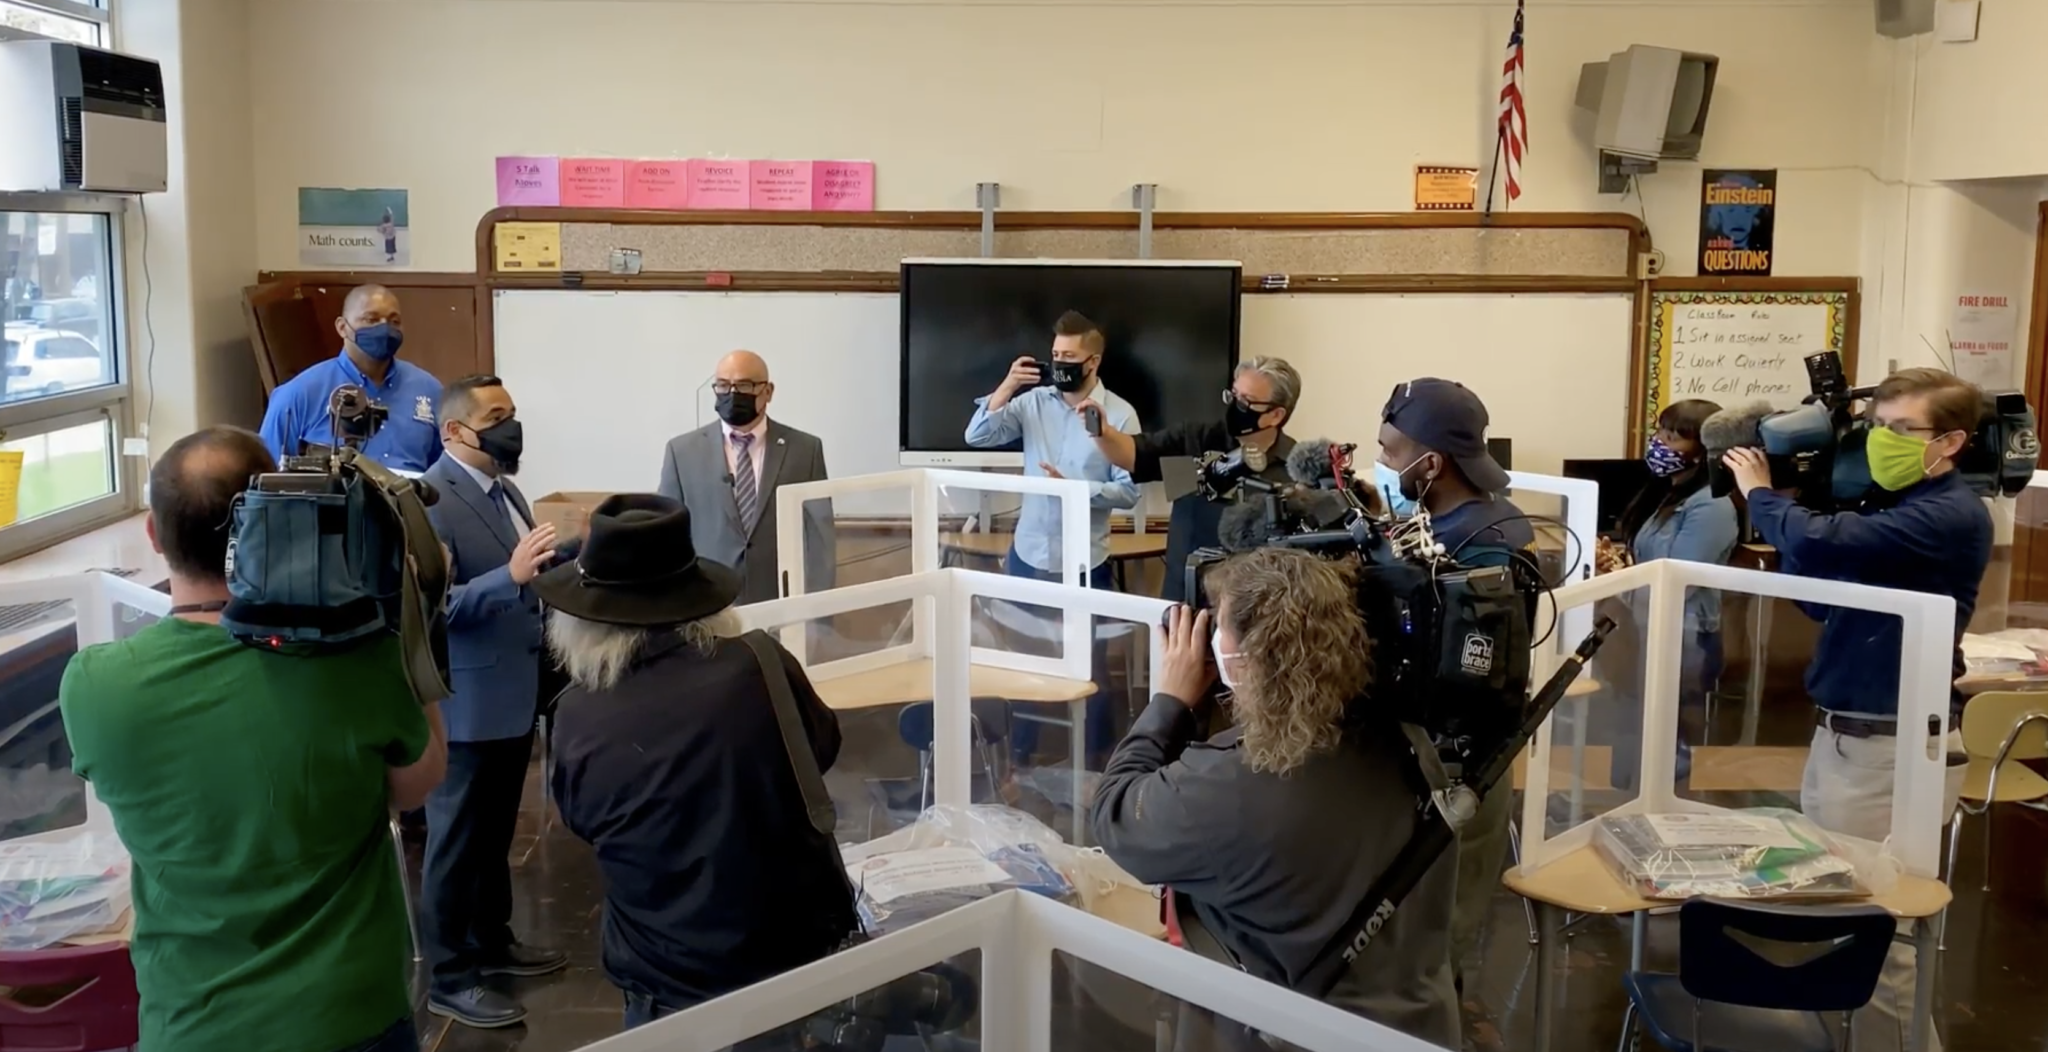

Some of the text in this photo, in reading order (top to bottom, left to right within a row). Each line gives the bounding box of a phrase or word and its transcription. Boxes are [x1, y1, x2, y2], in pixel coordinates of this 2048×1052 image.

[523, 165, 541, 173] Talk
[643, 167, 658, 175] ADD
[769, 168, 794, 176] REPEAT
[1705, 182, 1773, 205] Einstein
[308, 234, 375, 247] Math counts.
[1704, 250, 1769, 271] QUESTIONS
[1958, 296, 2008, 307] FIRE DRILL
[1690, 327, 1709, 343] Sit
[1690, 352, 1726, 369] Work
[1687, 376, 1706, 394] No
[1711, 376, 1741, 394] Cell
[1744, 378, 1792, 397] phones
